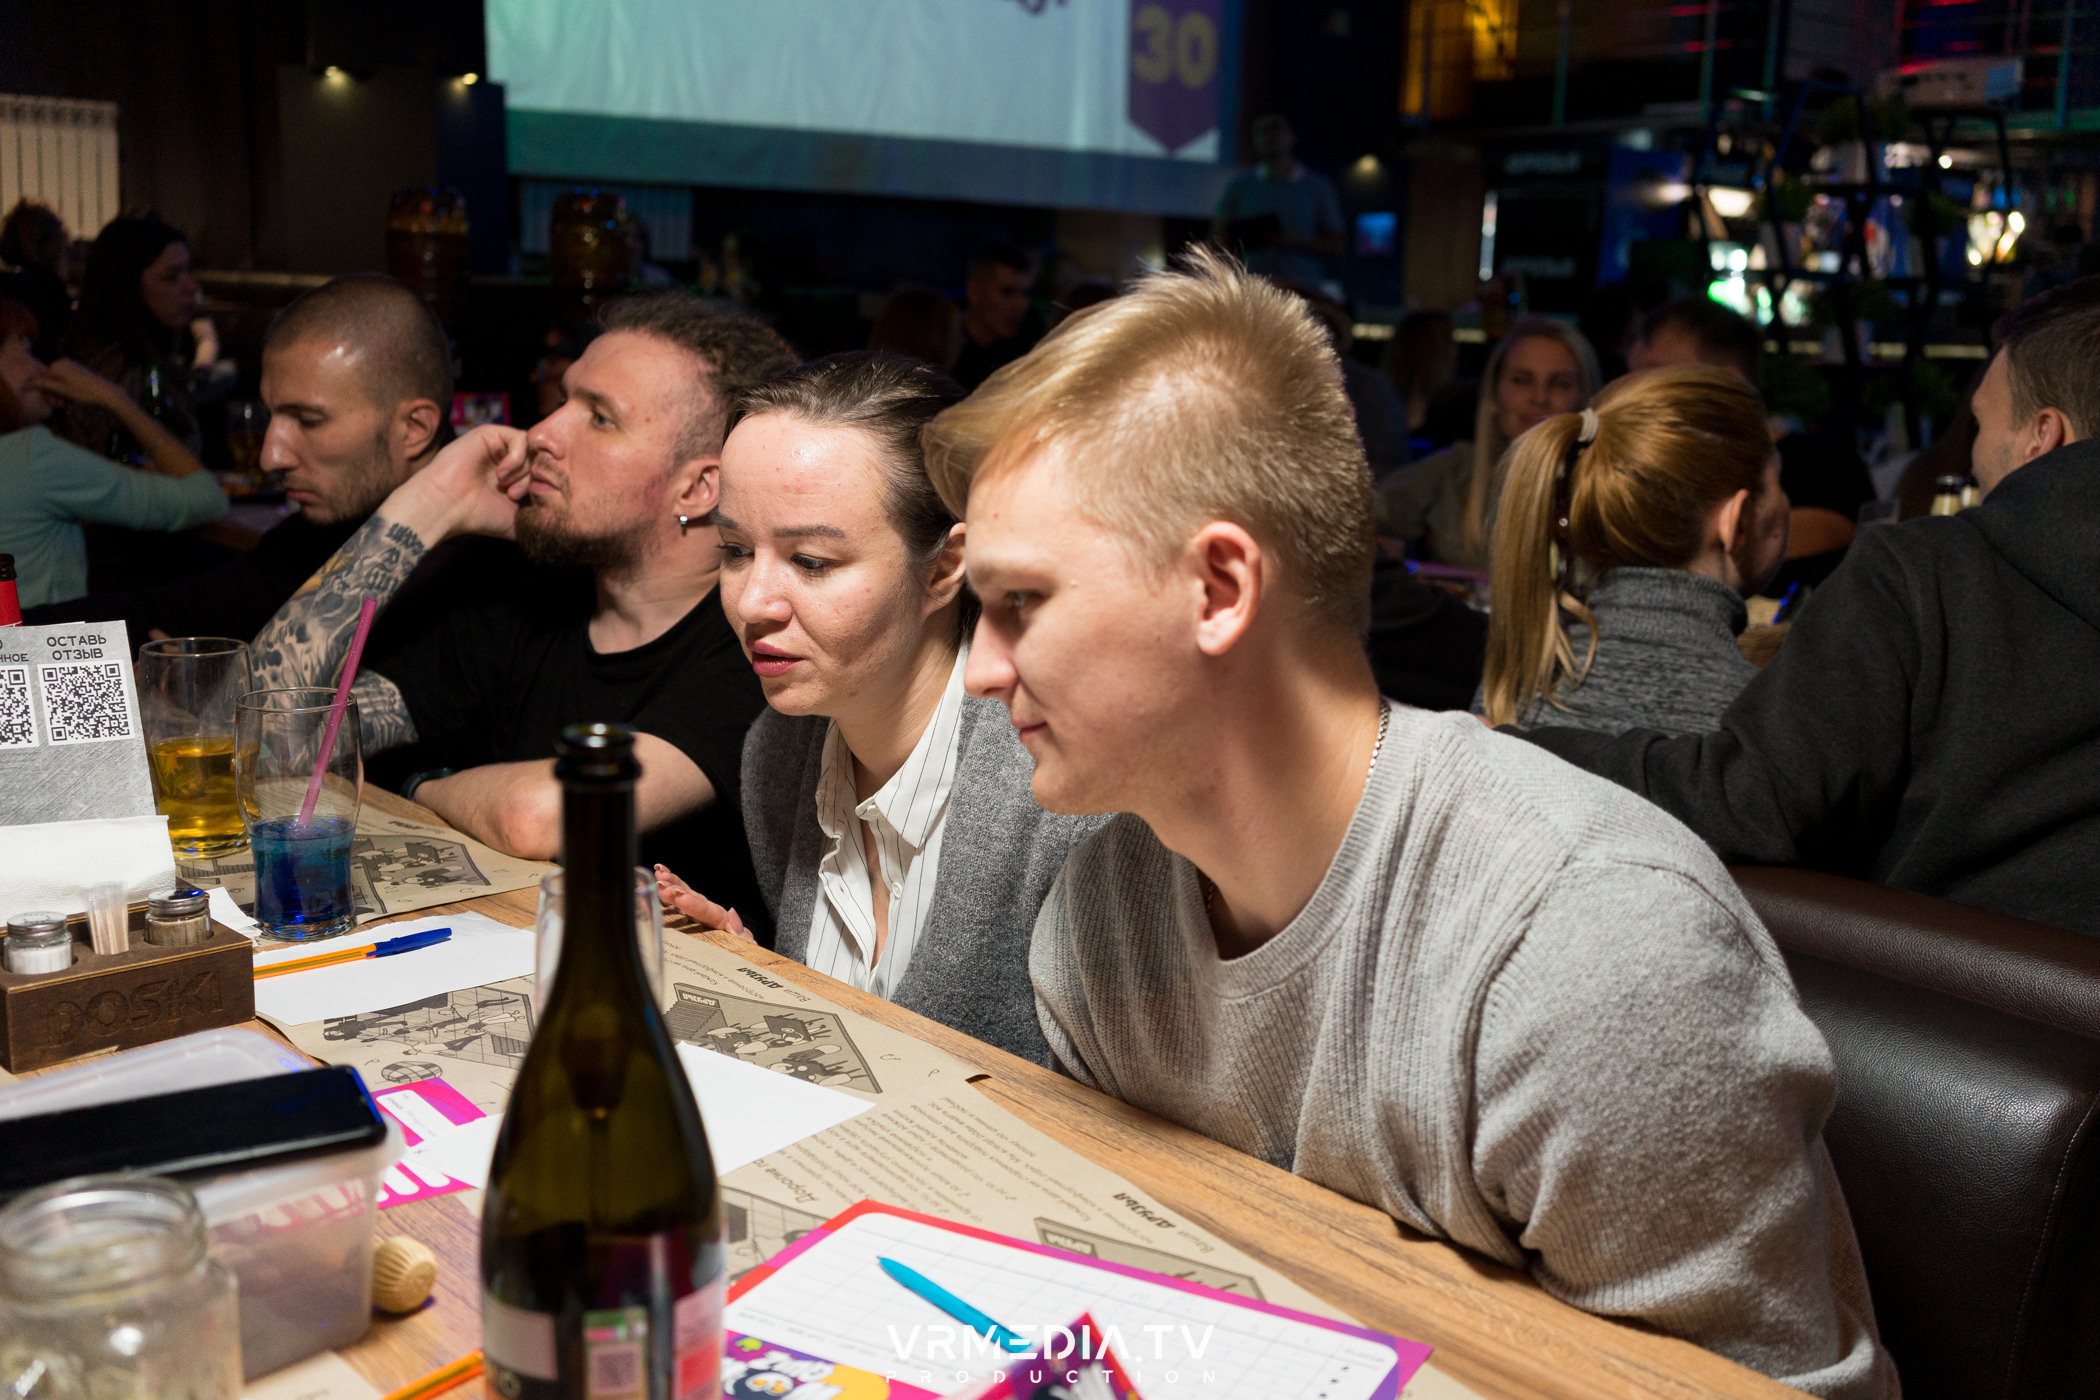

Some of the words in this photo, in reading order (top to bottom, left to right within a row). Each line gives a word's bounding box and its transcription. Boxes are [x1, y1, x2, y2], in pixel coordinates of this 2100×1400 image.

[1133, 4, 1219, 89] 30
[46, 634, 107, 647] ОСТАВЬ
[52, 648, 104, 661] ОТЗЫВ
[737, 967, 784, 989] ДРУЗЬЯ
[682, 993, 716, 1006] ДРУЗЬЯ
[765, 1167, 820, 1203] Дорогие
[1112, 1192, 1176, 1230] ДРУЗЬЯ
